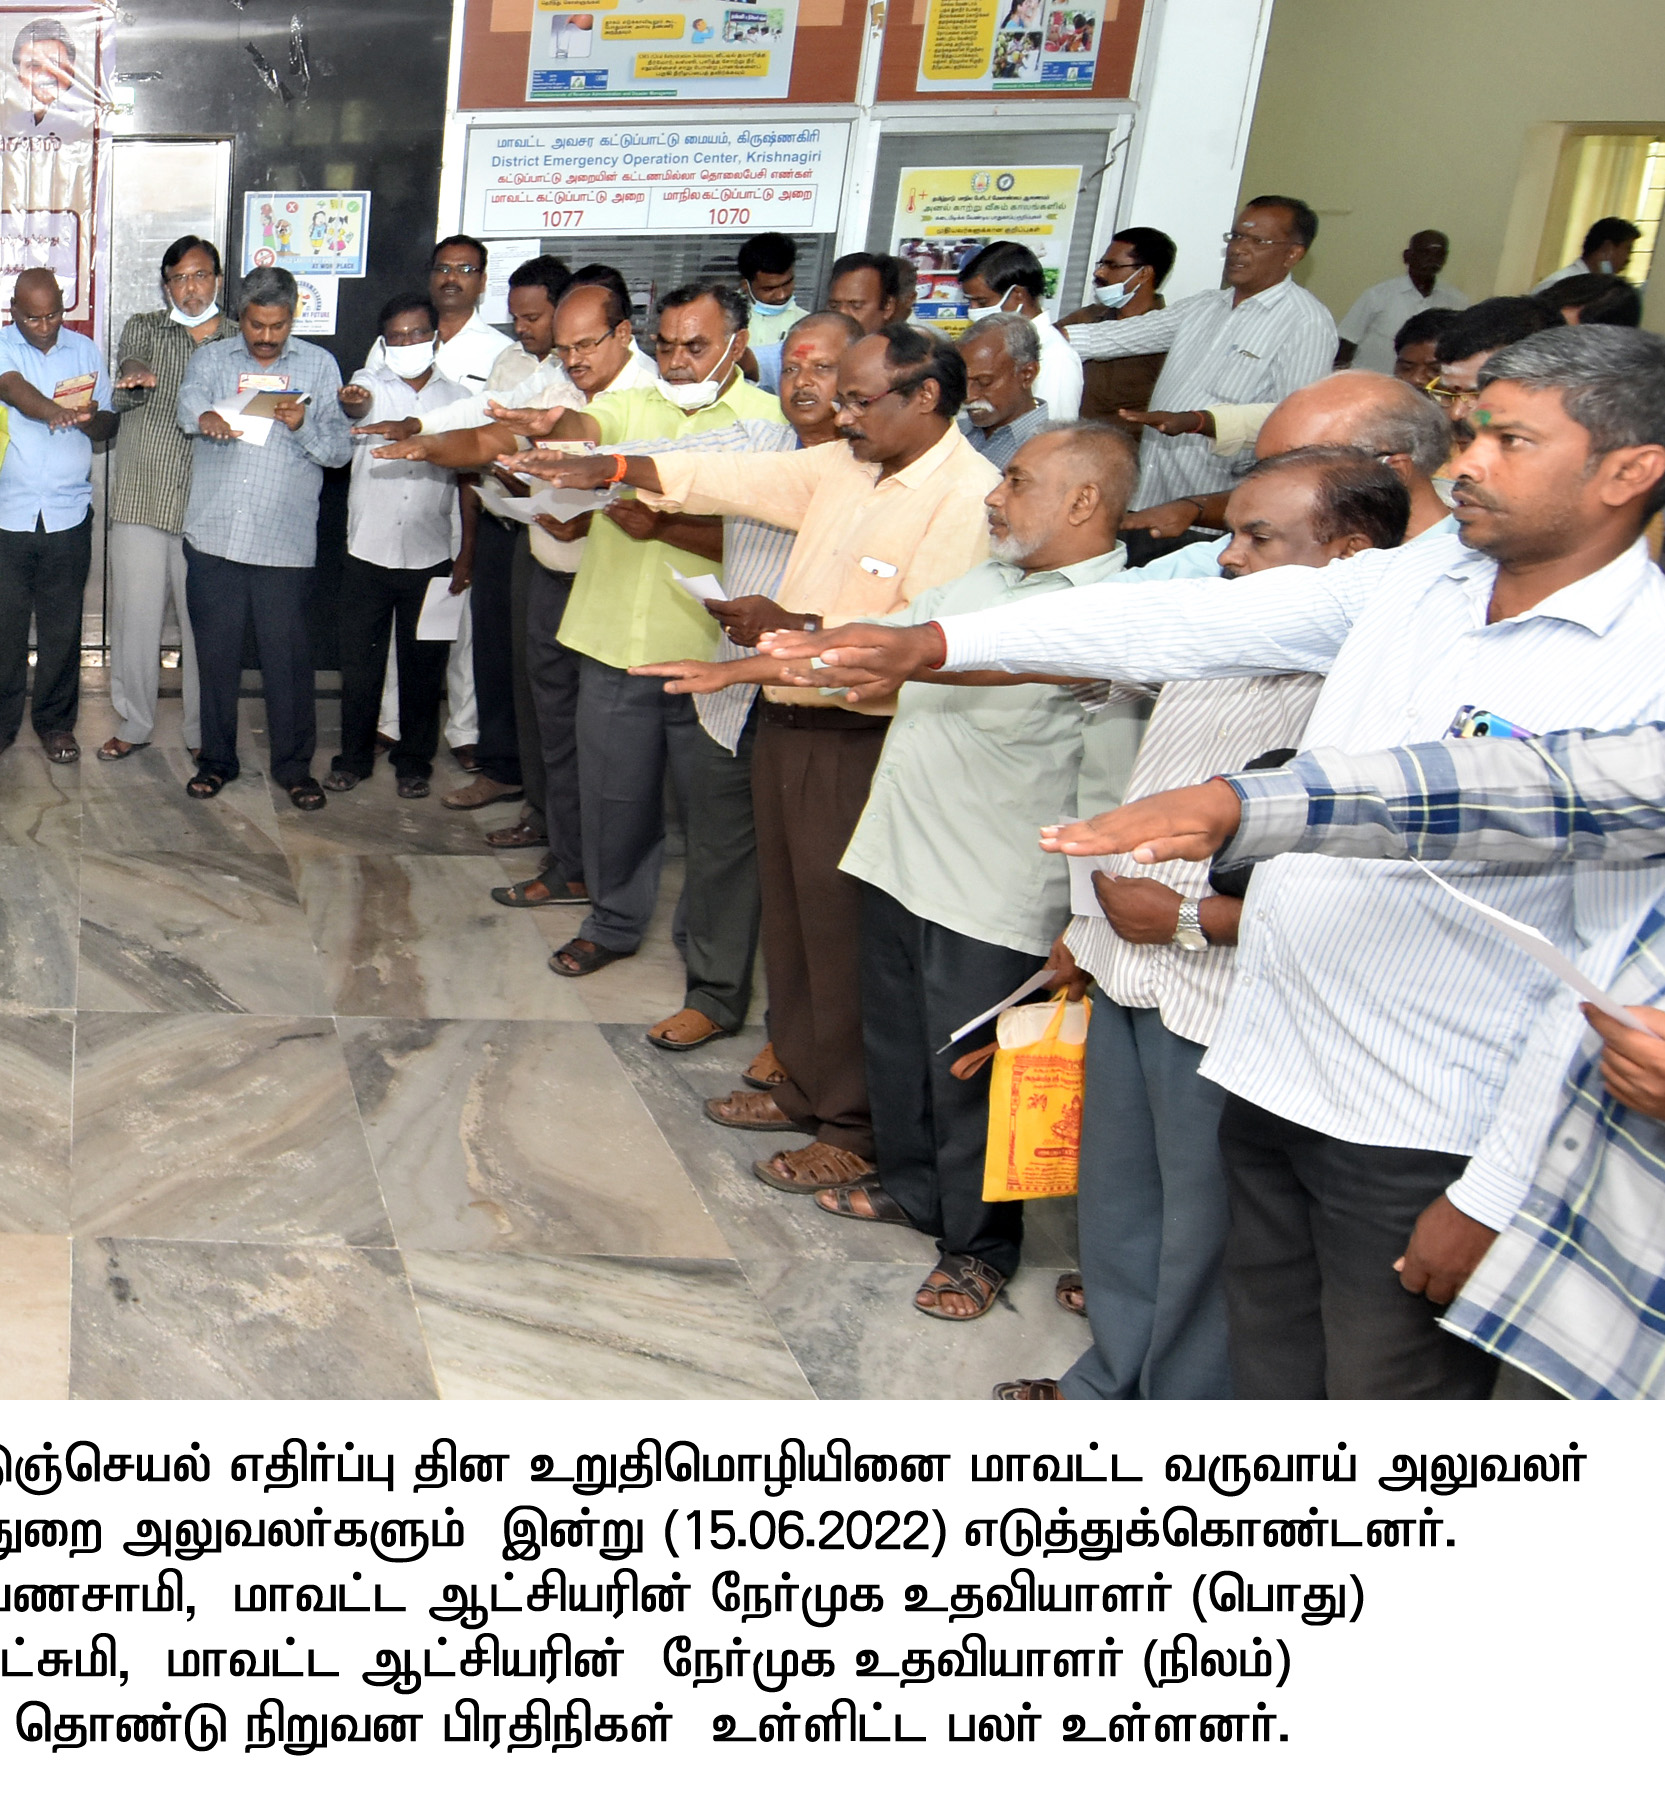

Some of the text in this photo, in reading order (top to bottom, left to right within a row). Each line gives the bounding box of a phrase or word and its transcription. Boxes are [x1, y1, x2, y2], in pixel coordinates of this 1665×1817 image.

[497, 129, 821, 150] மாவட்ட அவசர கட்டுப்பாட்டு மையம், கிருஷ்ணகிரி
[491, 150, 822, 168] District Emergency Operation Center, Krishnagiri
[497, 167, 813, 185] கட்டுப்பாட்டு அறையின் கட்டணமில்லா தொலைபேசி எண்கள்
[491, 190, 646, 204] மாவட்ட கட்டுப்பாட்டு அறை
[663, 187, 813, 203] மாநில கட்டுப்பாட்டு அறை
[542, 210, 584, 227] 1077
[709, 207, 751, 225] 1070
